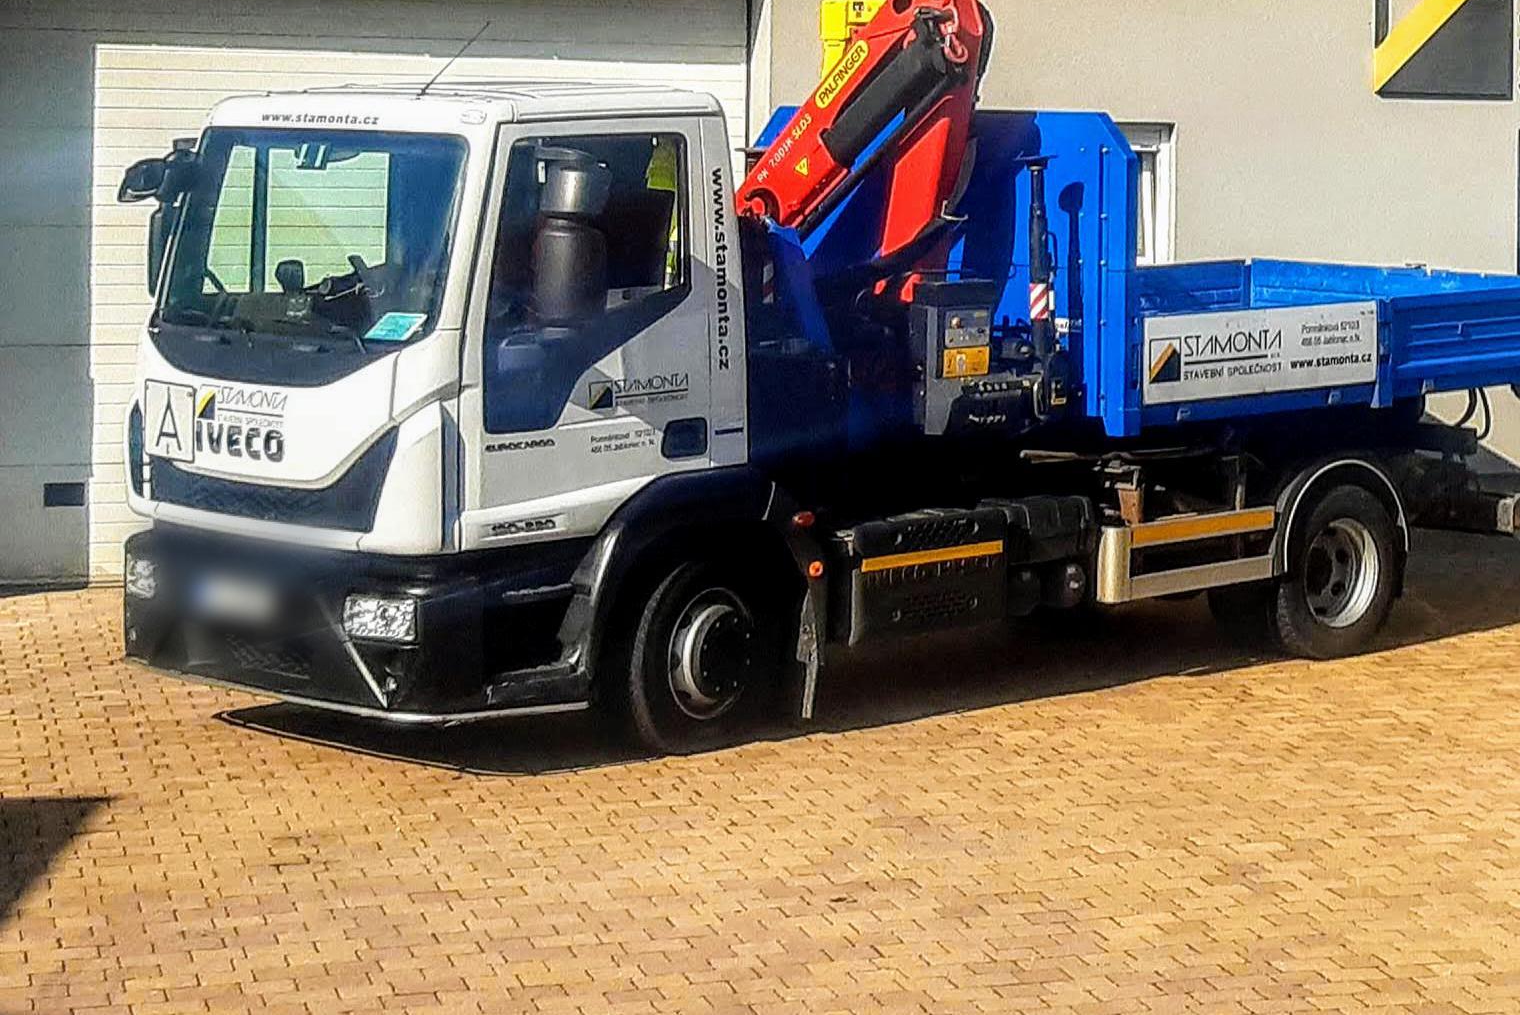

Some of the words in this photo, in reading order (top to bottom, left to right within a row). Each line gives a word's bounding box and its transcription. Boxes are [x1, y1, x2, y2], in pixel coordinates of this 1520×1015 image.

[819, 45, 866, 105] PALFINGER
[261, 112, 380, 126] www.stamonta.cz
[712, 168, 729, 370] www.stamonta.cz
[1184, 329, 1282, 357] STAMONTA
[1183, 366, 1224, 381] STAVEBNÍ
[1227, 361, 1282, 377] SPOLEČNOST
[1290, 352, 1372, 370] www.stamonta.cz
[614, 373, 688, 394] STAMONTA
[156, 386, 182, 451] A
[196, 421, 284, 463] IVECO
